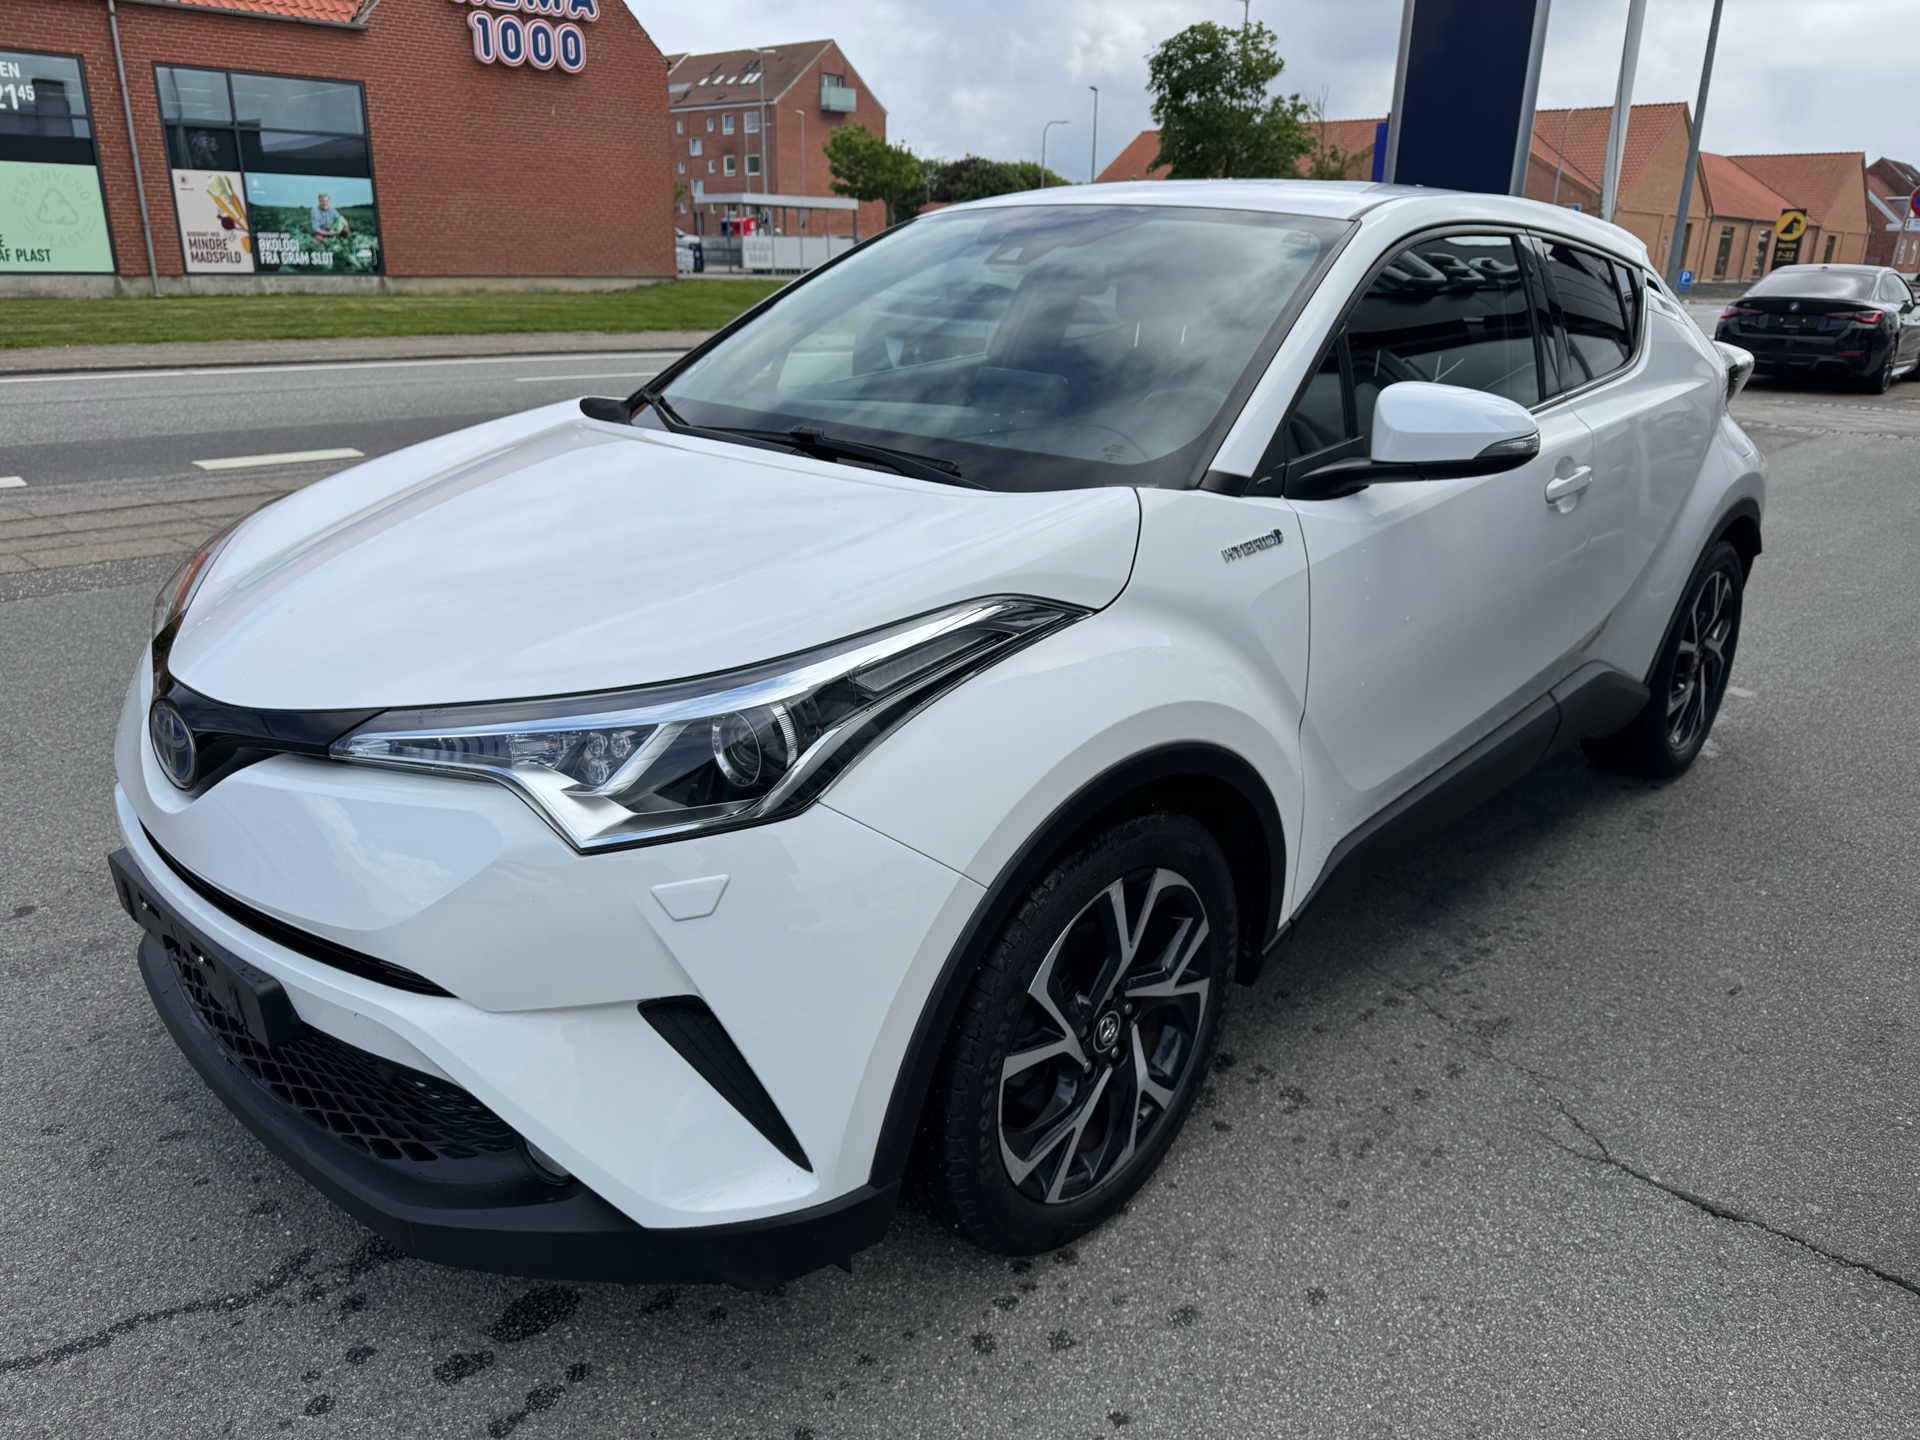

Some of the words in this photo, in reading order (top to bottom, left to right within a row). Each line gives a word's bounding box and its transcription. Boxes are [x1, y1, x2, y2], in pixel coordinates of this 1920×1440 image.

[470, 12, 585, 71] 1000
[188, 237, 228, 251] MINDRE
[258, 238, 300, 252] ØKOLOGI
[15, 248, 51, 262] PLAST
[190, 250, 242, 264] MADSPILD
[260, 251, 280, 265] FRA
[311, 251, 334, 265] SLOT
[1681, 271, 1691, 284] P
[1221, 534, 1277, 563] HYBRID
